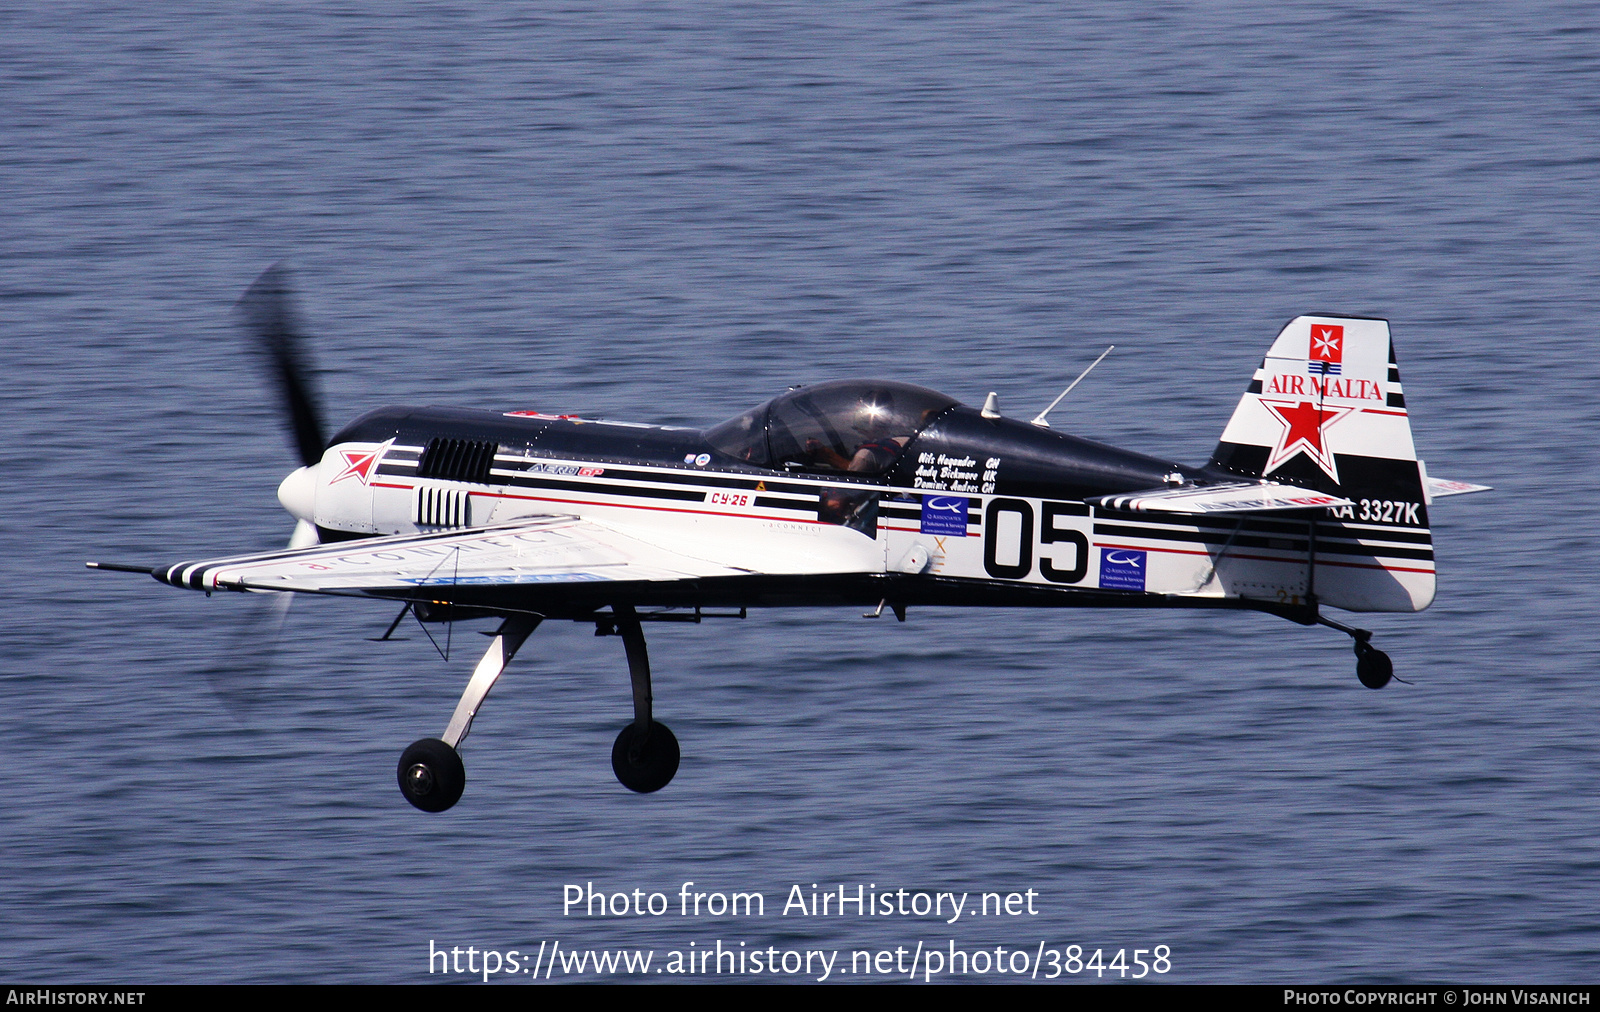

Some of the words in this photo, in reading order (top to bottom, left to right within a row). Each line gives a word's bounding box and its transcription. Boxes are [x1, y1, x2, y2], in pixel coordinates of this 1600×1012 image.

[1266, 374, 1305, 395] AIR
[1309, 376, 1383, 401] MALTA
[918, 452, 935, 464] Nils
[915, 464, 938, 482] Andy
[982, 470, 997, 482] UK
[914, 477, 947, 490] Dominic
[950, 480, 978, 493] Andres
[1359, 498, 1420, 525] 3327K
[983, 497, 1090, 584] 05
